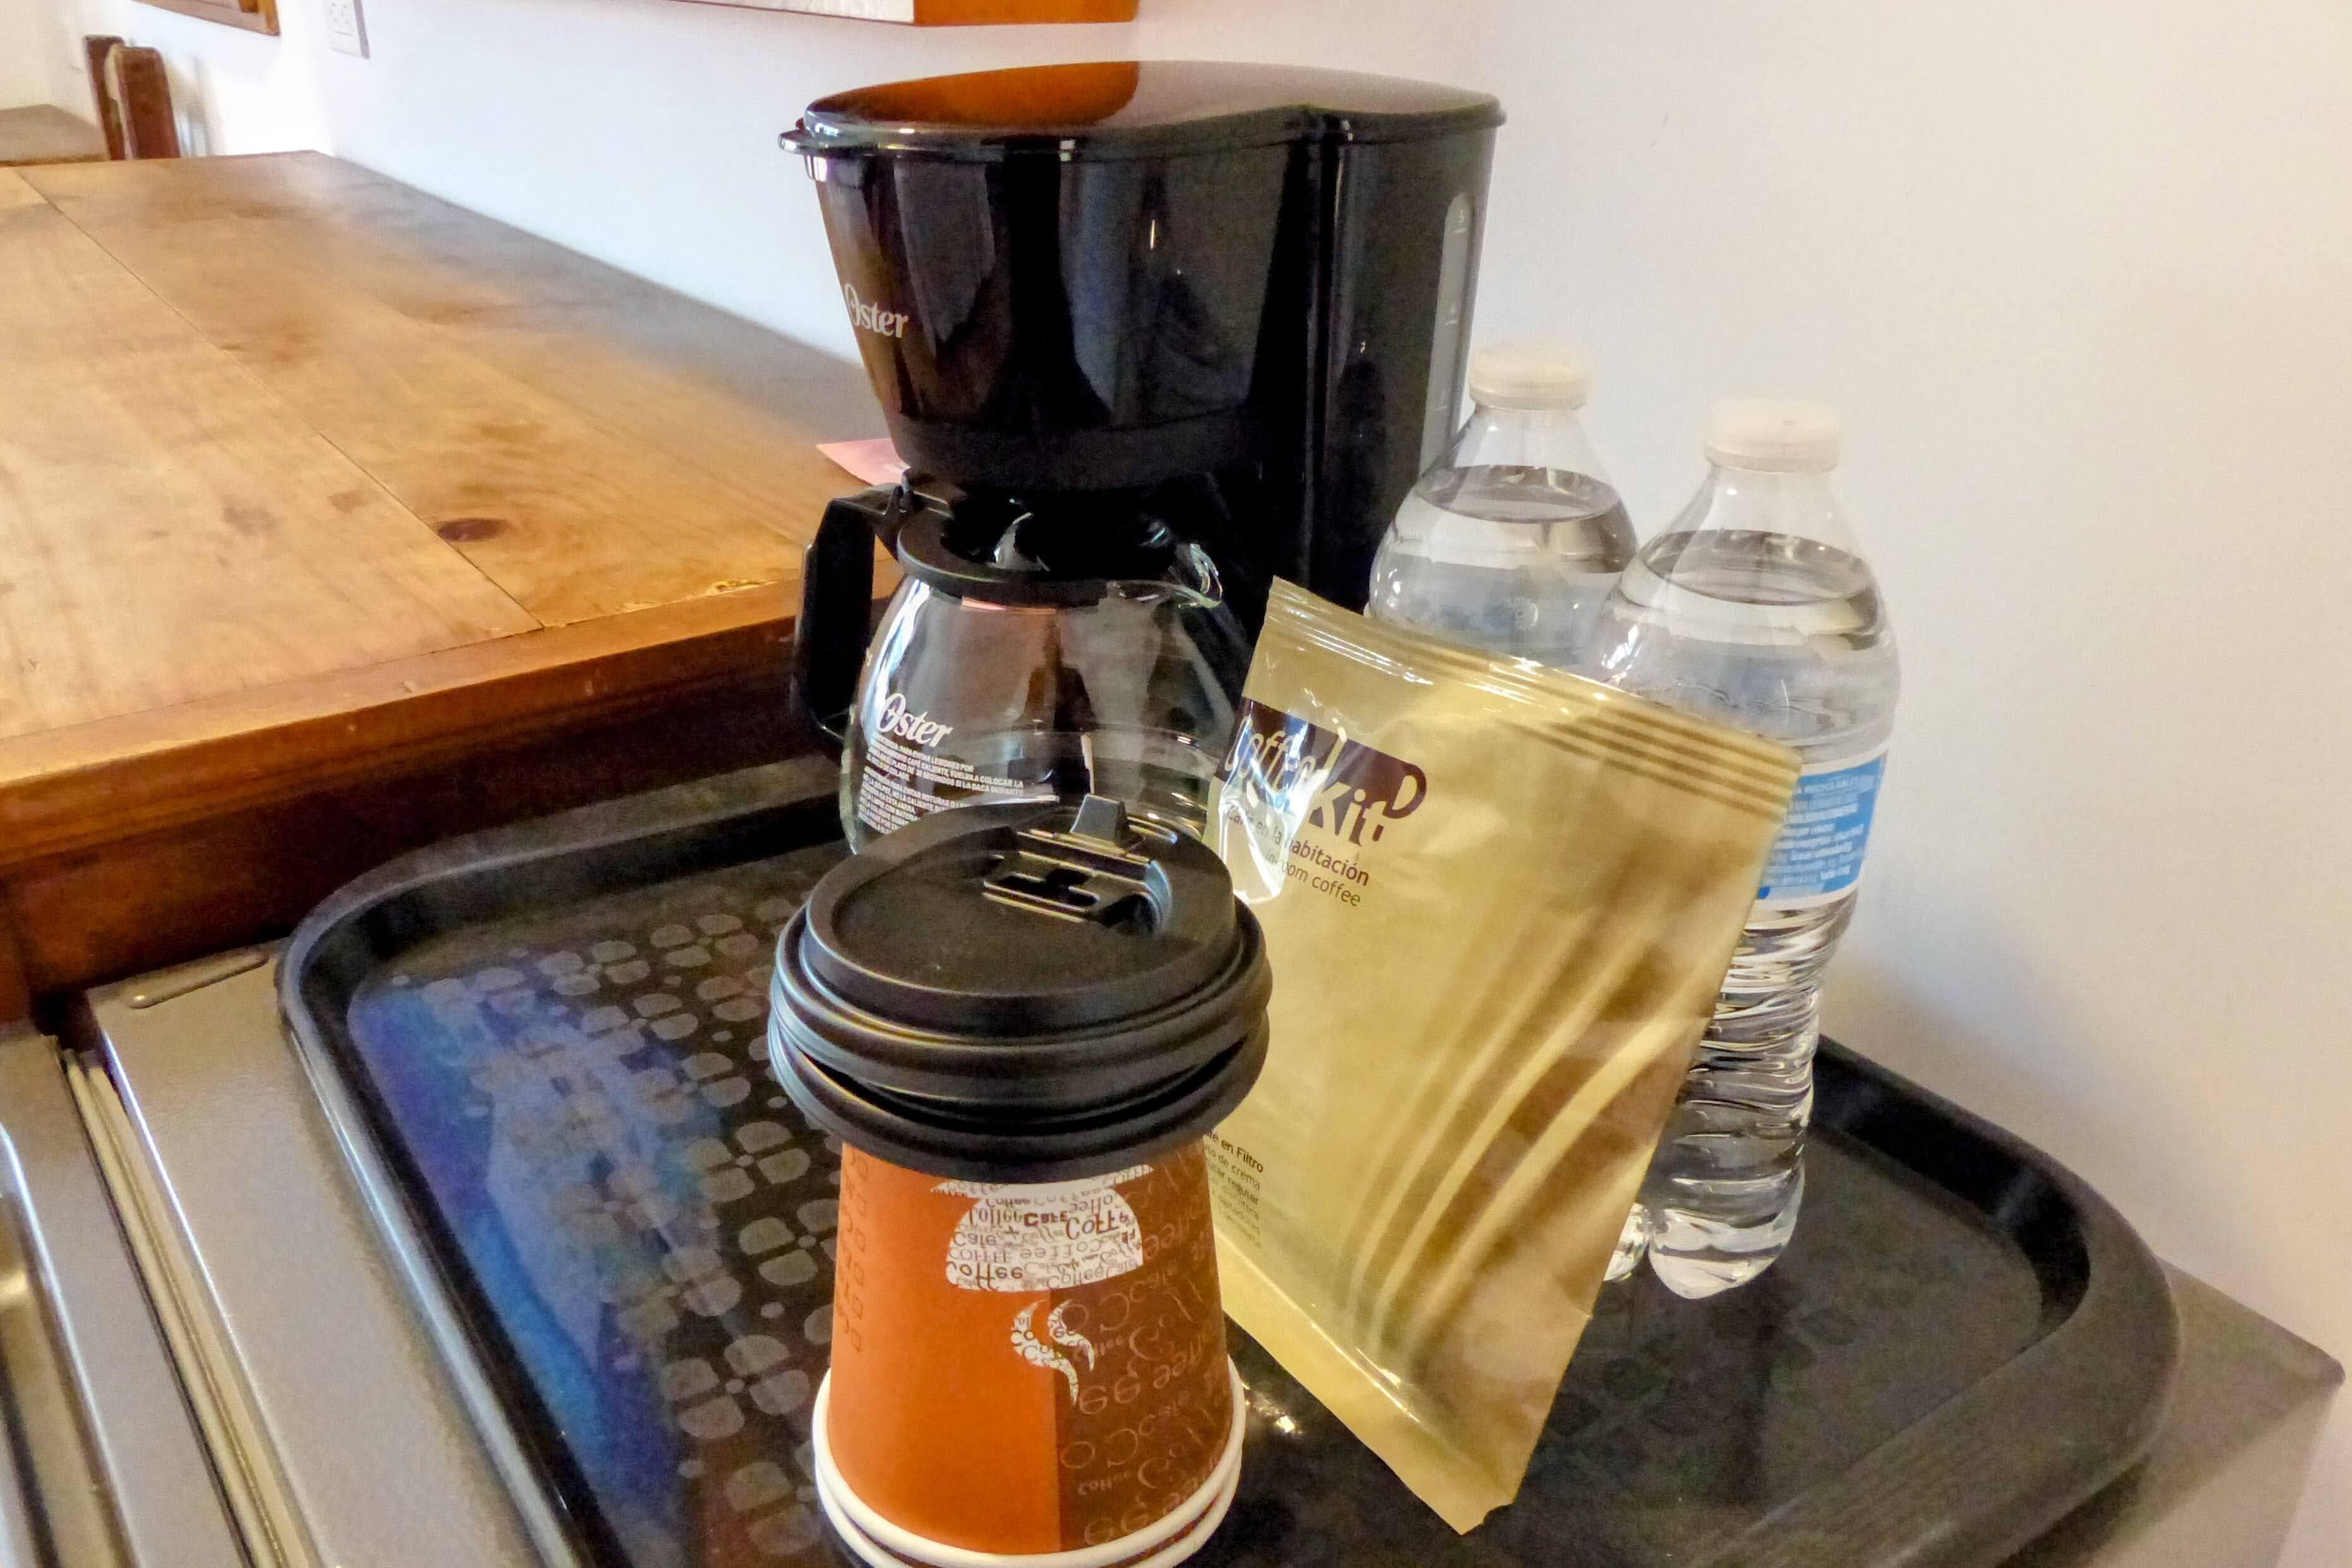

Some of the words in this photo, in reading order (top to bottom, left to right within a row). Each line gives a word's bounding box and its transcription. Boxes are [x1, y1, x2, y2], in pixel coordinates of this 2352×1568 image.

[845, 283, 909, 338] Oster
[878, 693, 953, 747] Oster
[1312, 876, 1361, 906] coffee
[1221, 1140, 1234, 1154] en
[1236, 1146, 1263, 1173] Filtro
[1232, 1165, 1260, 1191] crema
